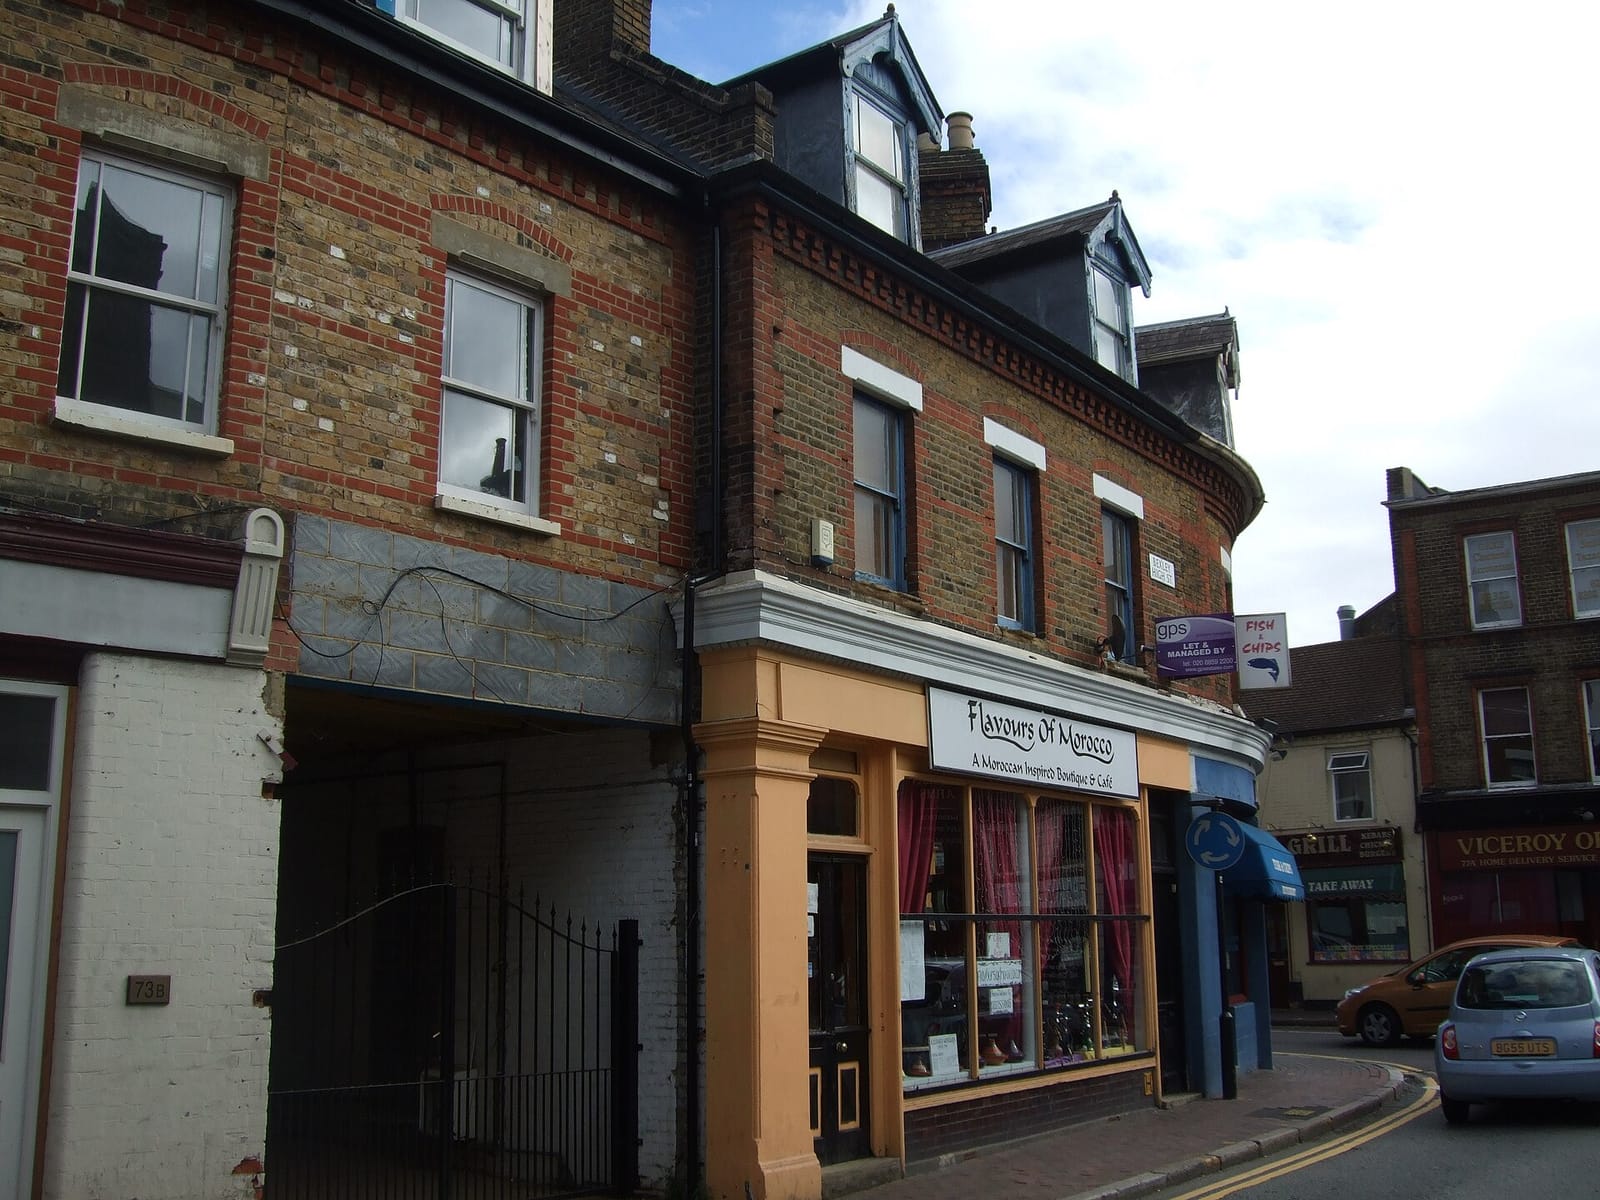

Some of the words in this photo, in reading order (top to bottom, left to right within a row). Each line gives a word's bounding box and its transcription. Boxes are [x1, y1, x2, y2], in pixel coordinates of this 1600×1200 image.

[1152, 557, 1172, 573] BEXLEY
[1152, 567, 1166, 582] HIGH
[1158, 623, 1187, 640] gps
[1246, 619, 1275, 632] FISH
[1167, 648, 1212, 658] MANAGED
[1213, 647, 1226, 655] BY
[1183, 642, 1200, 650] LET
[1202, 641, 1209, 649] &
[1242, 641, 1281, 654] CHIPS
[967, 700, 1035, 752] Flavours
[1038, 717, 1057, 745] Of
[1059, 722, 1115, 764] Morocco
[972, 753, 980, 768] A
[982, 754, 1024, 775] Moroccan
[1024, 761, 1055, 782] Inspired
[1056, 767, 1088, 788] Boutique
[1089, 774, 1096, 785] &
[1097, 773, 1113, 789] Café
[1360, 831, 1392, 840] KEBABS
[1288, 834, 1352, 855] GRILL
[1456, 832, 1567, 856] VICEROY
[1479, 857, 1506, 867] HOME
[1508, 855, 1555, 865] DELIVERY
[1557, 854, 1596, 863] SERVICE
[1308, 881, 1337, 892] TAKE
[1340, 879, 1374, 891] AWAY
[135, 981, 165, 999] 73B
[1495, 1042, 1524, 1053] BG55
[1527, 1042, 1550, 1052] UTS
